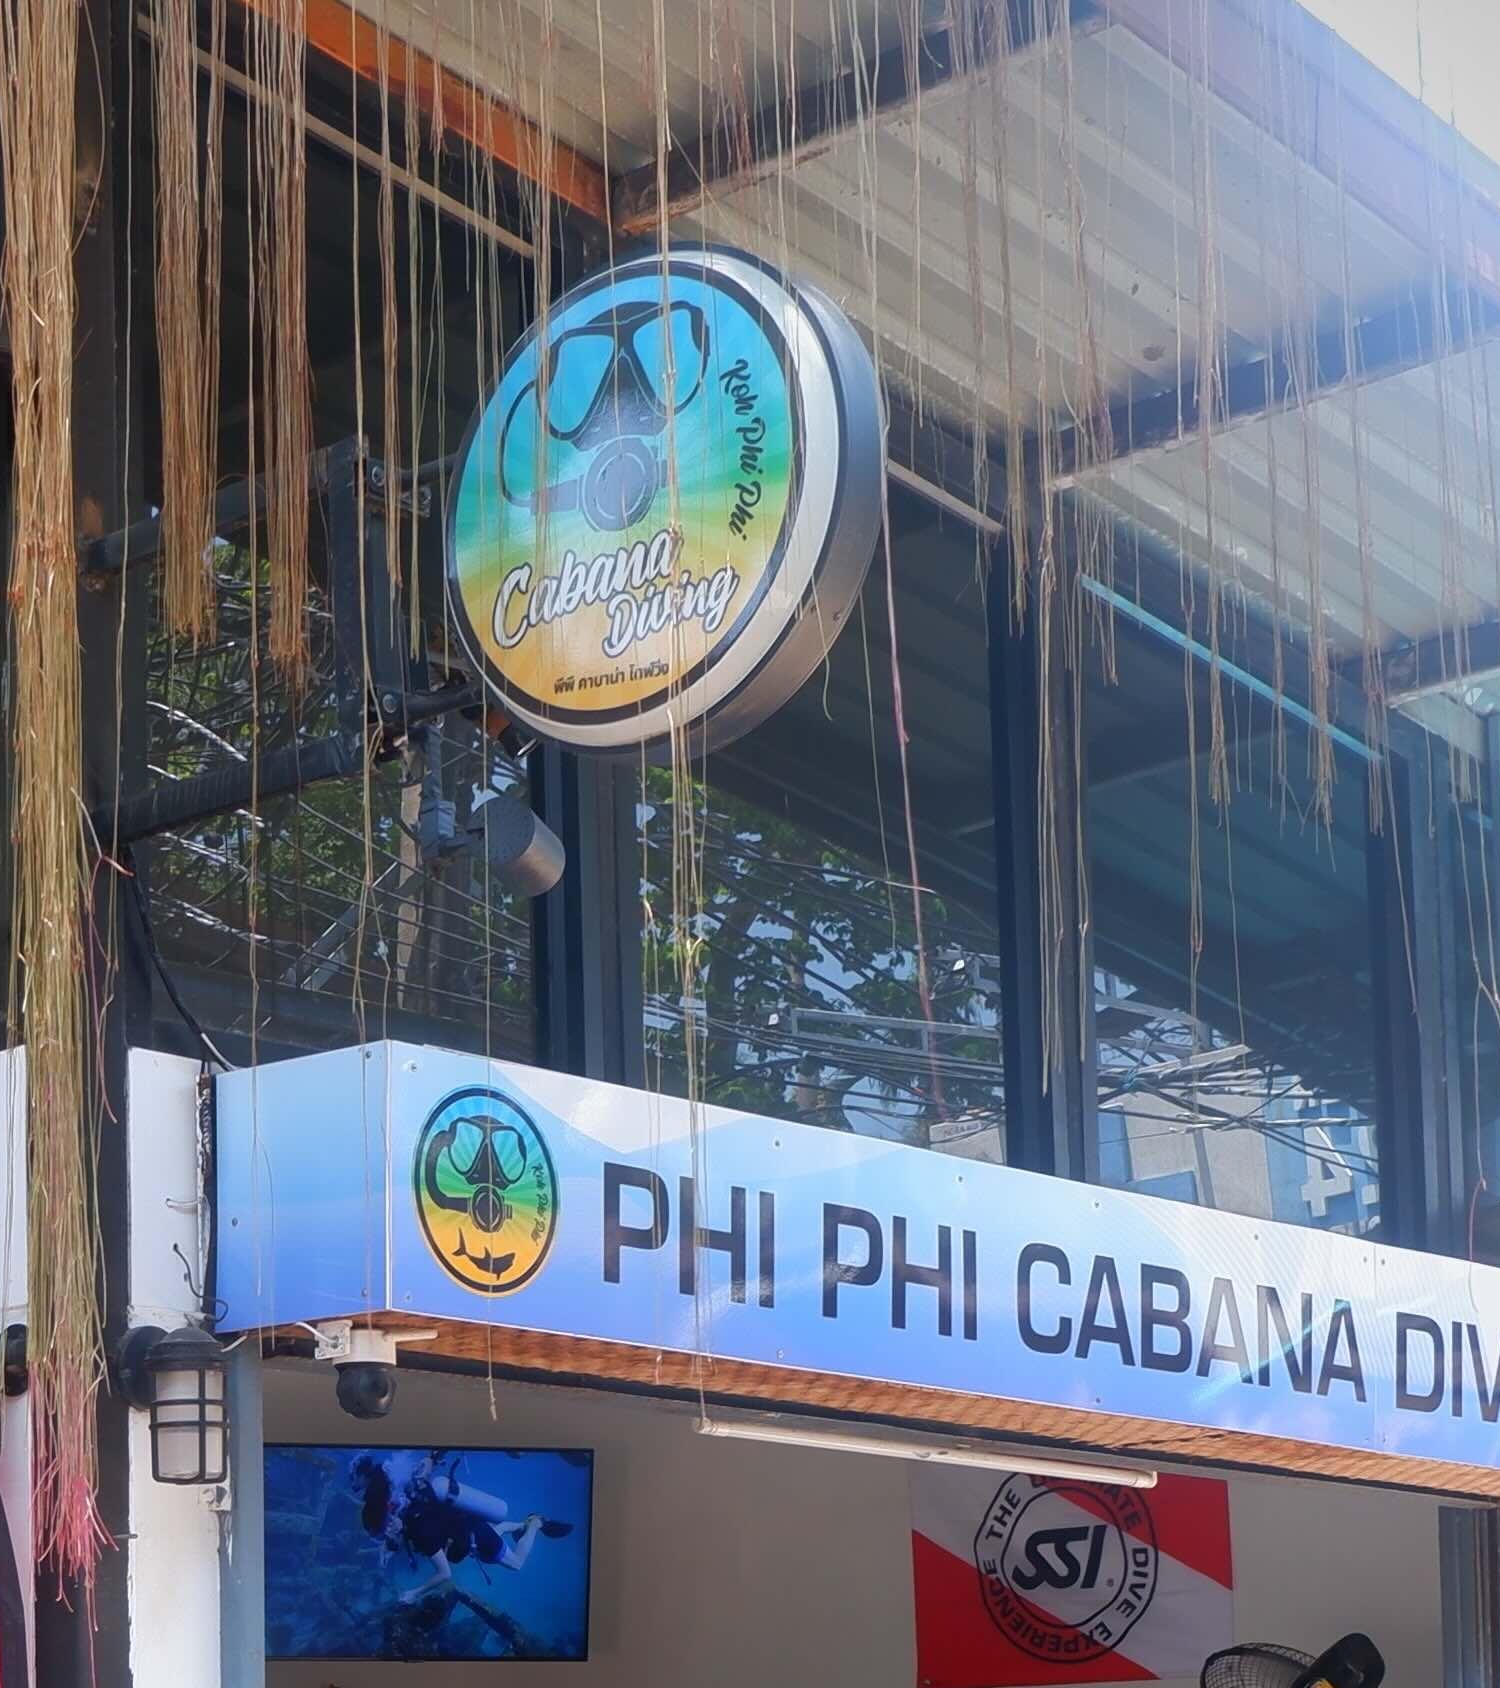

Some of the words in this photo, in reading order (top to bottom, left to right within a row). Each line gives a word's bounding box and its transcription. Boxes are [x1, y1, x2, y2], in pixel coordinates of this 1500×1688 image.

[720, 359, 751, 416] Koh
[736, 418, 765, 478] Phi
[728, 482, 761, 543] Phi
[493, 527, 682, 650] Cabana
[601, 566, 737, 658] Diving
[602, 1162, 775, 1308] PHI
[822, 1200, 978, 1343] PHI
[1016, 1242, 1365, 1404] CABANA
[985, 1488, 1021, 1541] THE
[1012, 1525, 1107, 1591] SSI
[1116, 1547, 1149, 1618] DIVE
[981, 1557, 1114, 1654] EXPERIENCE
